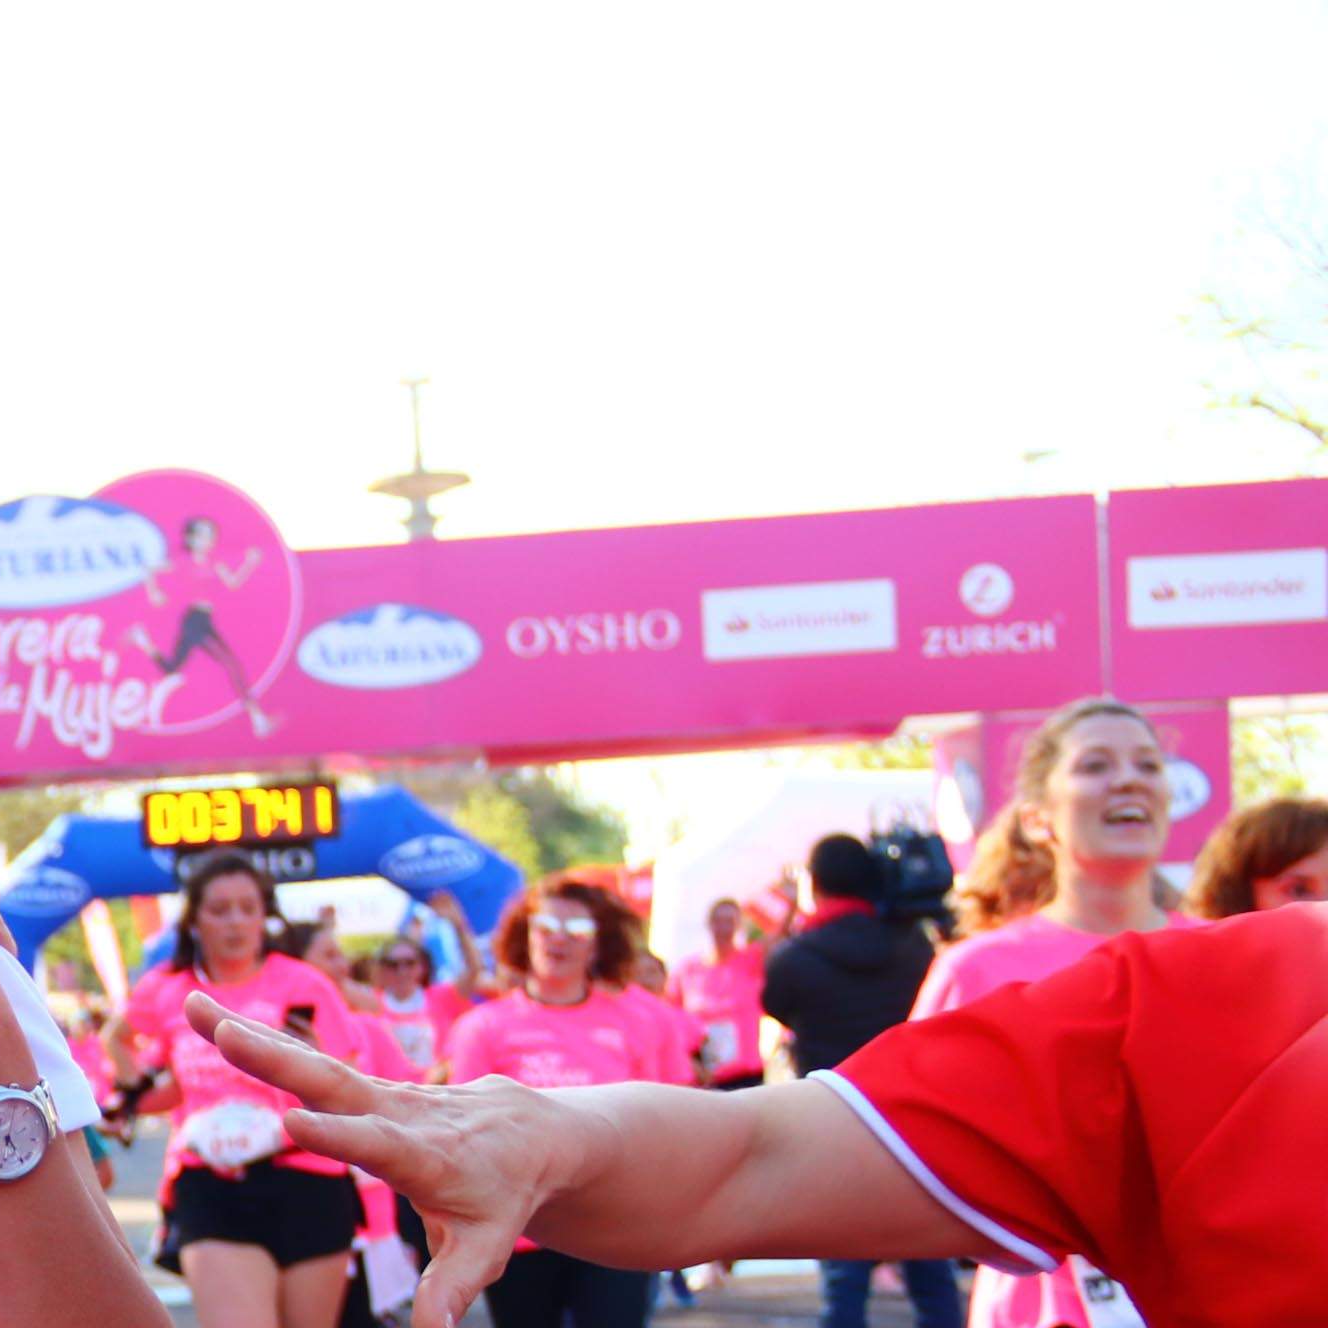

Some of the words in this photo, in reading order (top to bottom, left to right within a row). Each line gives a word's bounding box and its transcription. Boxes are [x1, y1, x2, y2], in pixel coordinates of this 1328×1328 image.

[506, 608, 682, 658] OYSHO
[922, 617, 1057, 658] ZURICH
[15, 651, 184, 759] Mujer
